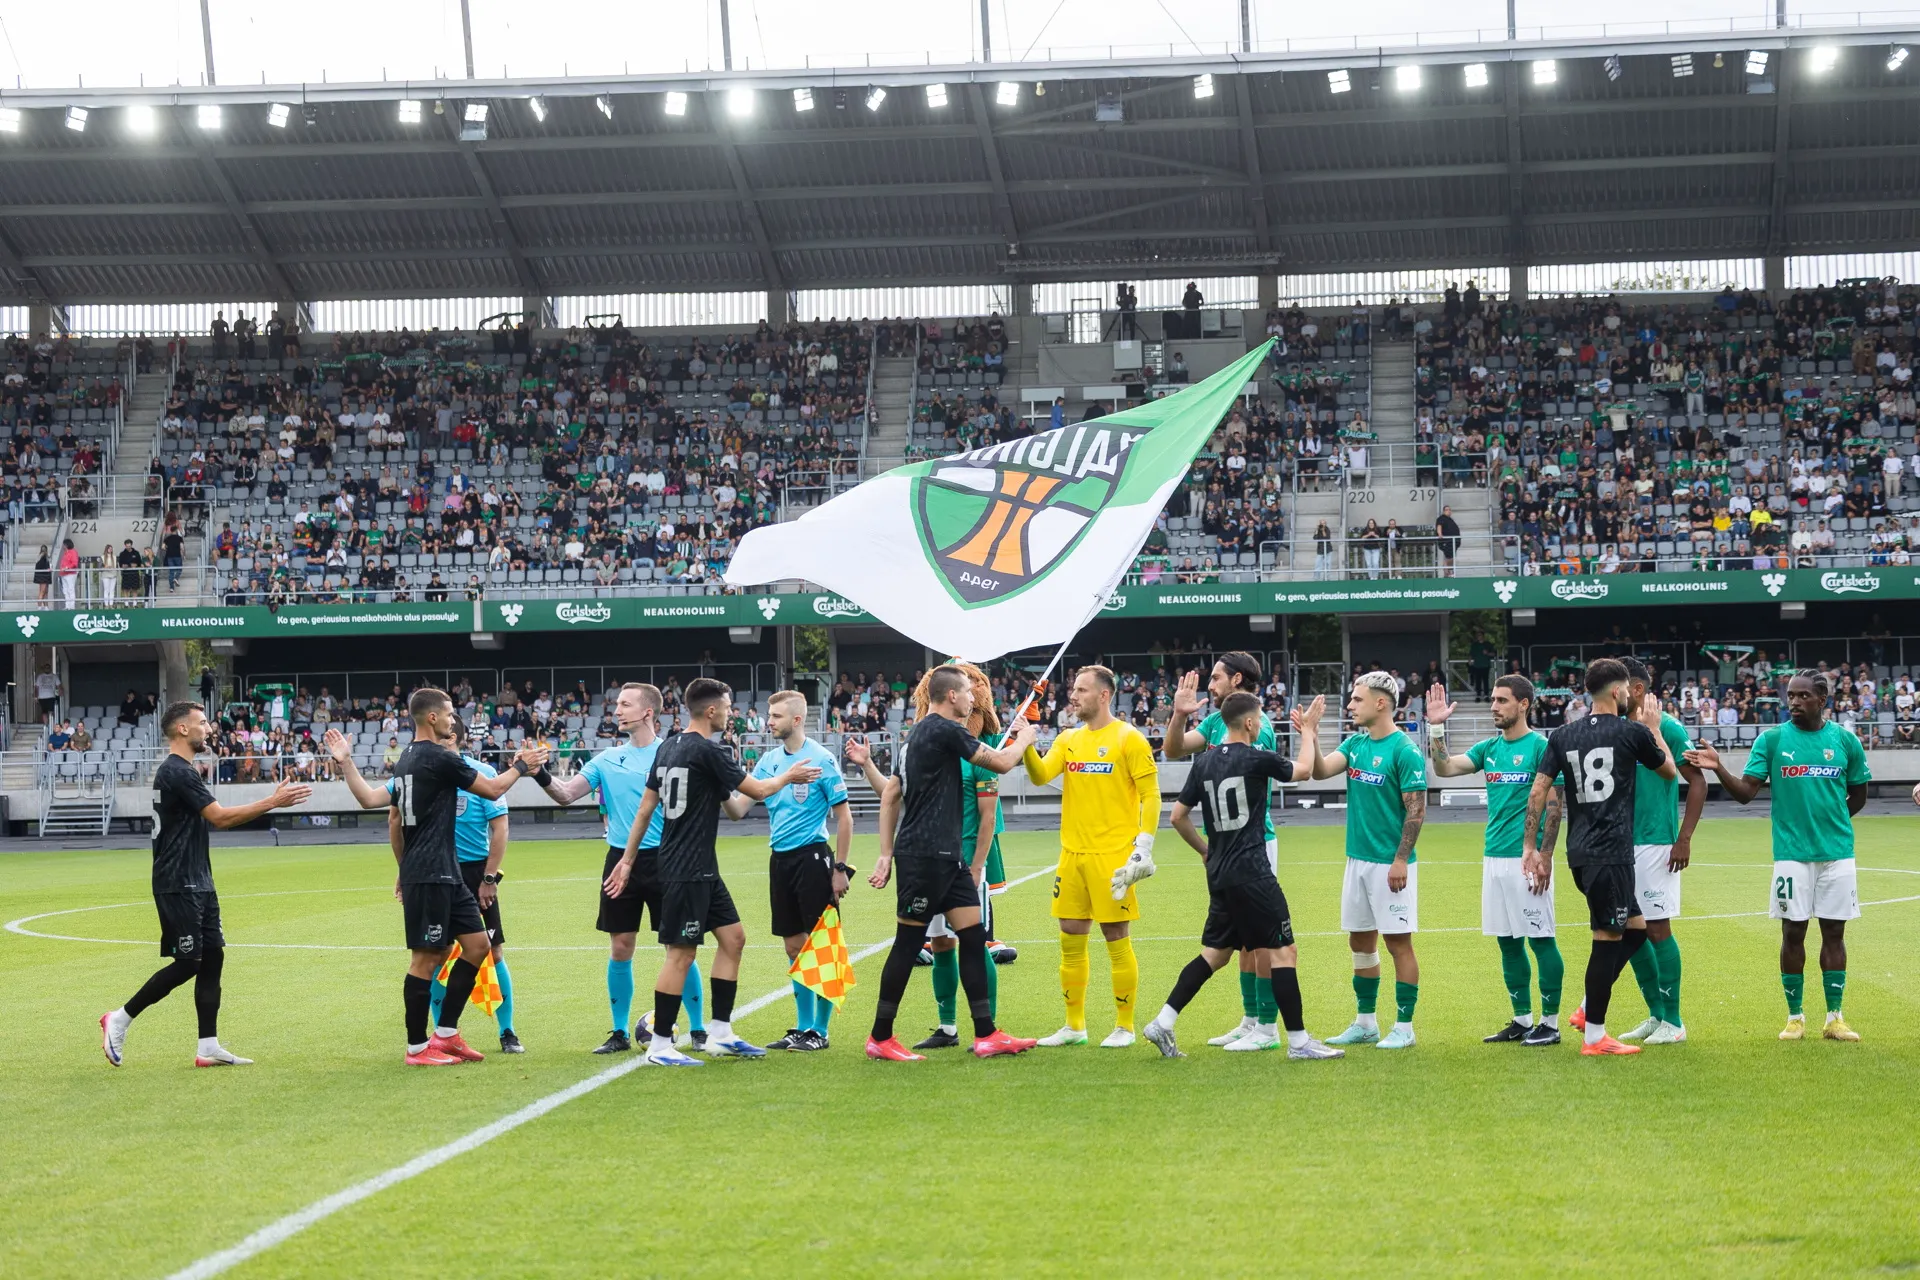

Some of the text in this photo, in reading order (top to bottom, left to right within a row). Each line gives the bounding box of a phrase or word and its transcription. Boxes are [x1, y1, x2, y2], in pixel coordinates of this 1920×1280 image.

[1349, 491, 1375, 503] 220
[1409, 489, 1435, 501] 219
[71, 521, 98, 534] 224
[132, 520, 158, 533] 223
[1641, 582, 1728, 592] NEALKOHOLINIS
[1820, 572, 1880, 594] Carlsberg
[1275, 589, 1460, 603] Ko gero, geriausias nealkoholinis alus pasaulyje
[1551, 579, 1608, 601] Carlsberg
[1159, 594, 1242, 604] NEALKOHOLINIS
[556, 602, 611, 624] Carlsberg
[643, 606, 725, 616] NEALKOHOLINIS
[73, 613, 129, 635] Carlsberg
[162, 617, 245, 627] NEALKOHOLINIS
[277, 612, 459, 626] Ko gero, geriausias nealkoholinis alus pasaulyje
[1566, 747, 1615, 804] 18
[1781, 766, 1841, 778] TOPsport
[1204, 776, 1249, 832] 10
[1776, 876, 1793, 899] 21
